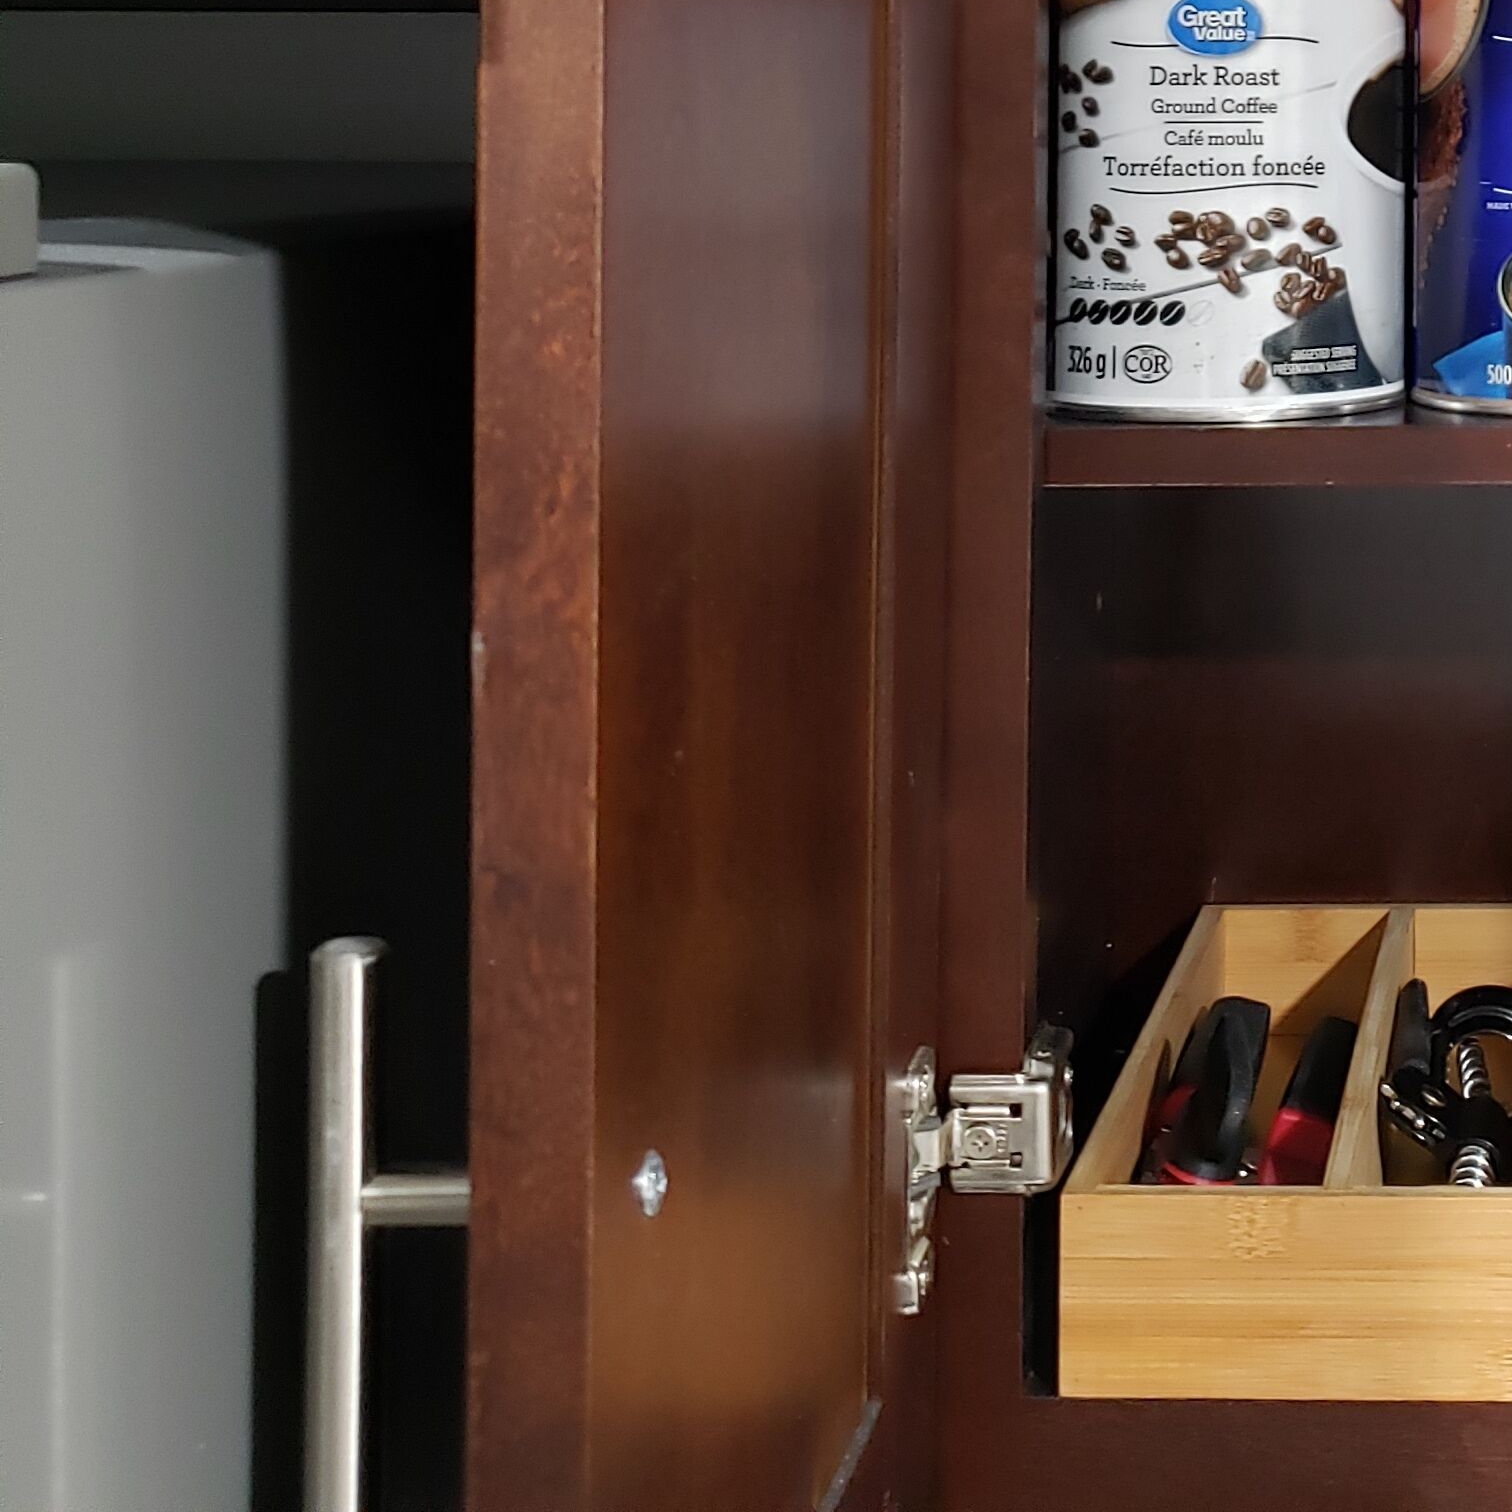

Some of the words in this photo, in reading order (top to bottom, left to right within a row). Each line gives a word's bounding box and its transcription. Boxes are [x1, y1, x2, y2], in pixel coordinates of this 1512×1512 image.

[1177, 4, 1247, 28] Great
[1192, 26, 1247, 41] Value
[1149, 64, 1207, 87] Dark
[1213, 65, 1280, 87] Roast
[1151, 98, 1216, 115] Ground
[1221, 98, 1278, 115] Coffee
[1164, 129, 1204, 146] Café
[1208, 129, 1264, 146] moulu
[1103, 156, 1246, 178] Torréfaction
[1252, 155, 1326, 177] foncée
[1067, 345, 1092, 374] 326
[1096, 354, 1106, 379] g
[1487, 364, 1512, 385] 500
